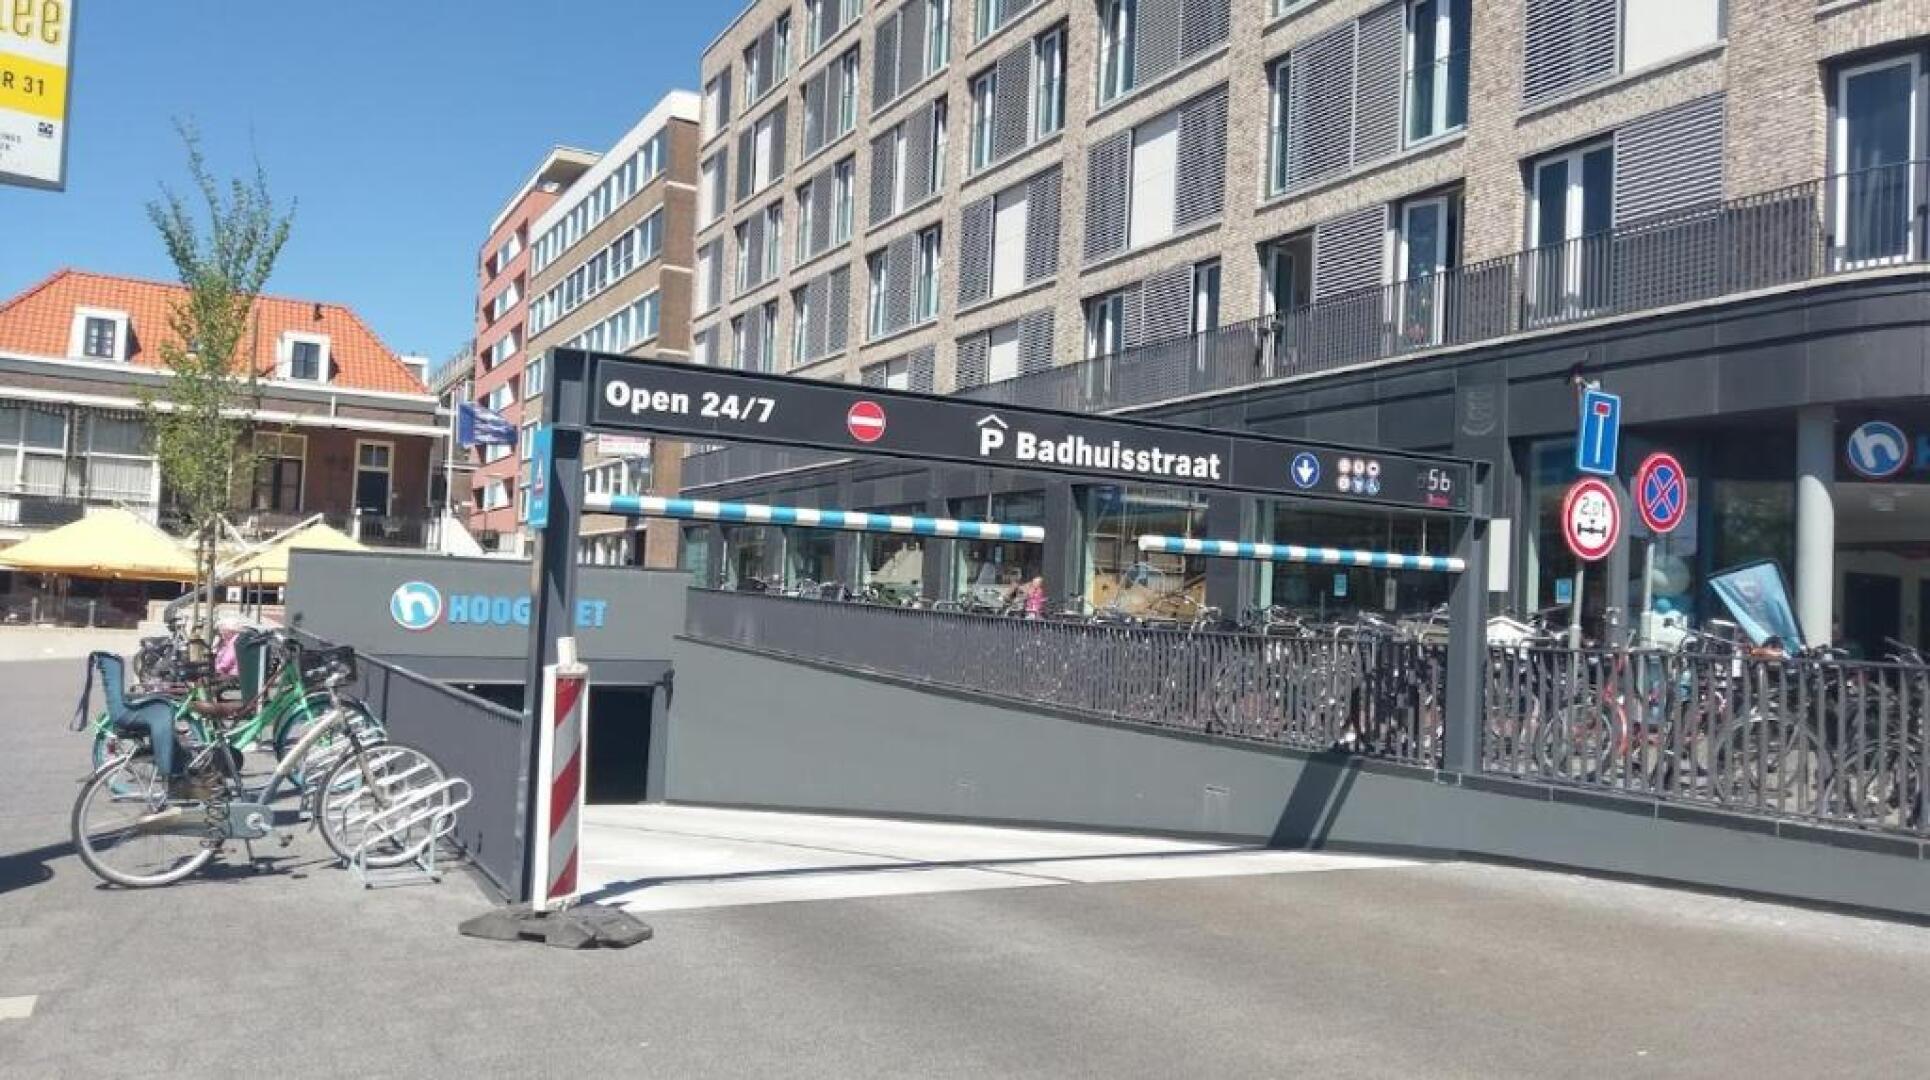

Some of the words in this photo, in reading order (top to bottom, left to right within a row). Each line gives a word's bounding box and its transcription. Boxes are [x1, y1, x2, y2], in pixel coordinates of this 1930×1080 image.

[24, 77, 45, 96] 31
[606, 380, 689, 414] Open
[700, 391, 776, 423] 24/7
[1016, 431, 1221, 480] Badhuisstraat
